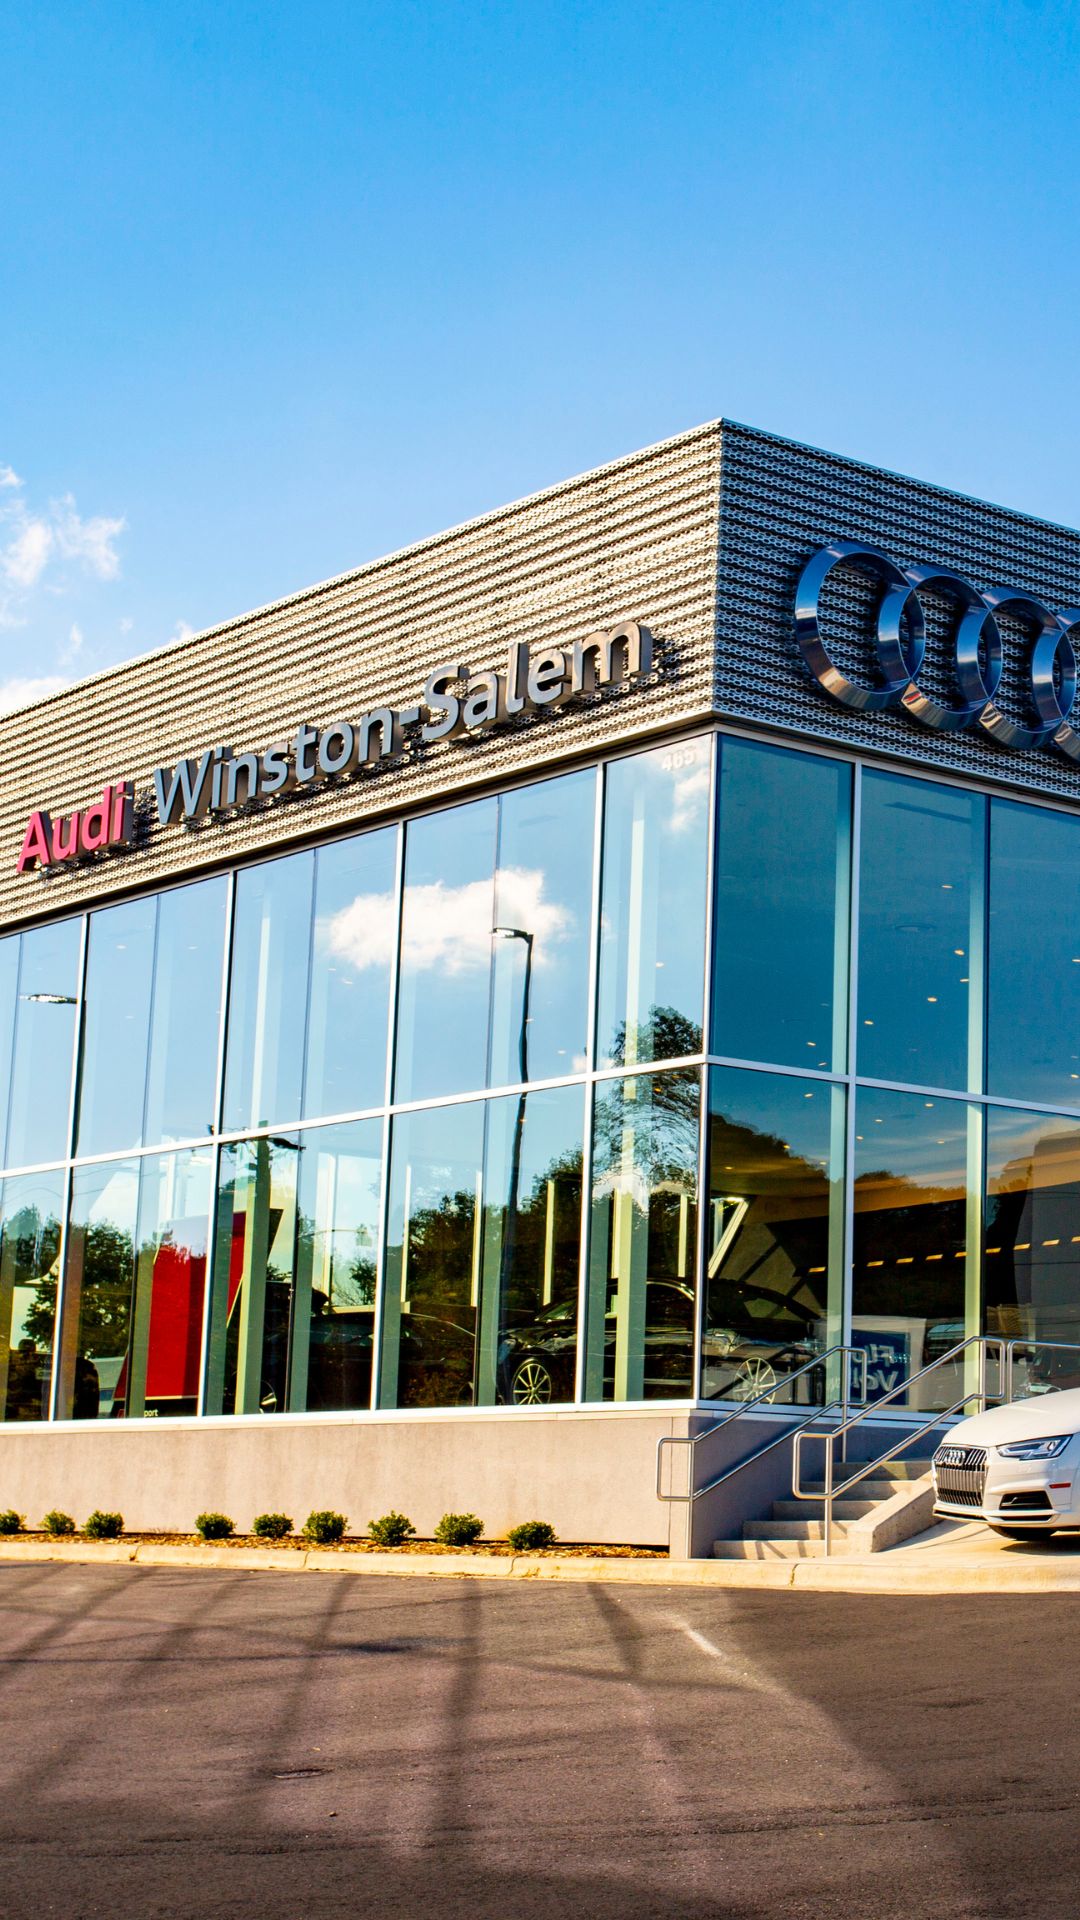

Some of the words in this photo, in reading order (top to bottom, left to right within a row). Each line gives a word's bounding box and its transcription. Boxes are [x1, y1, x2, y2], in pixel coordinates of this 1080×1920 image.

[16, 781, 134, 873] Audi
[153, 621, 653, 825] Winston-Salem
[144, 1408, 158, 1418] port
